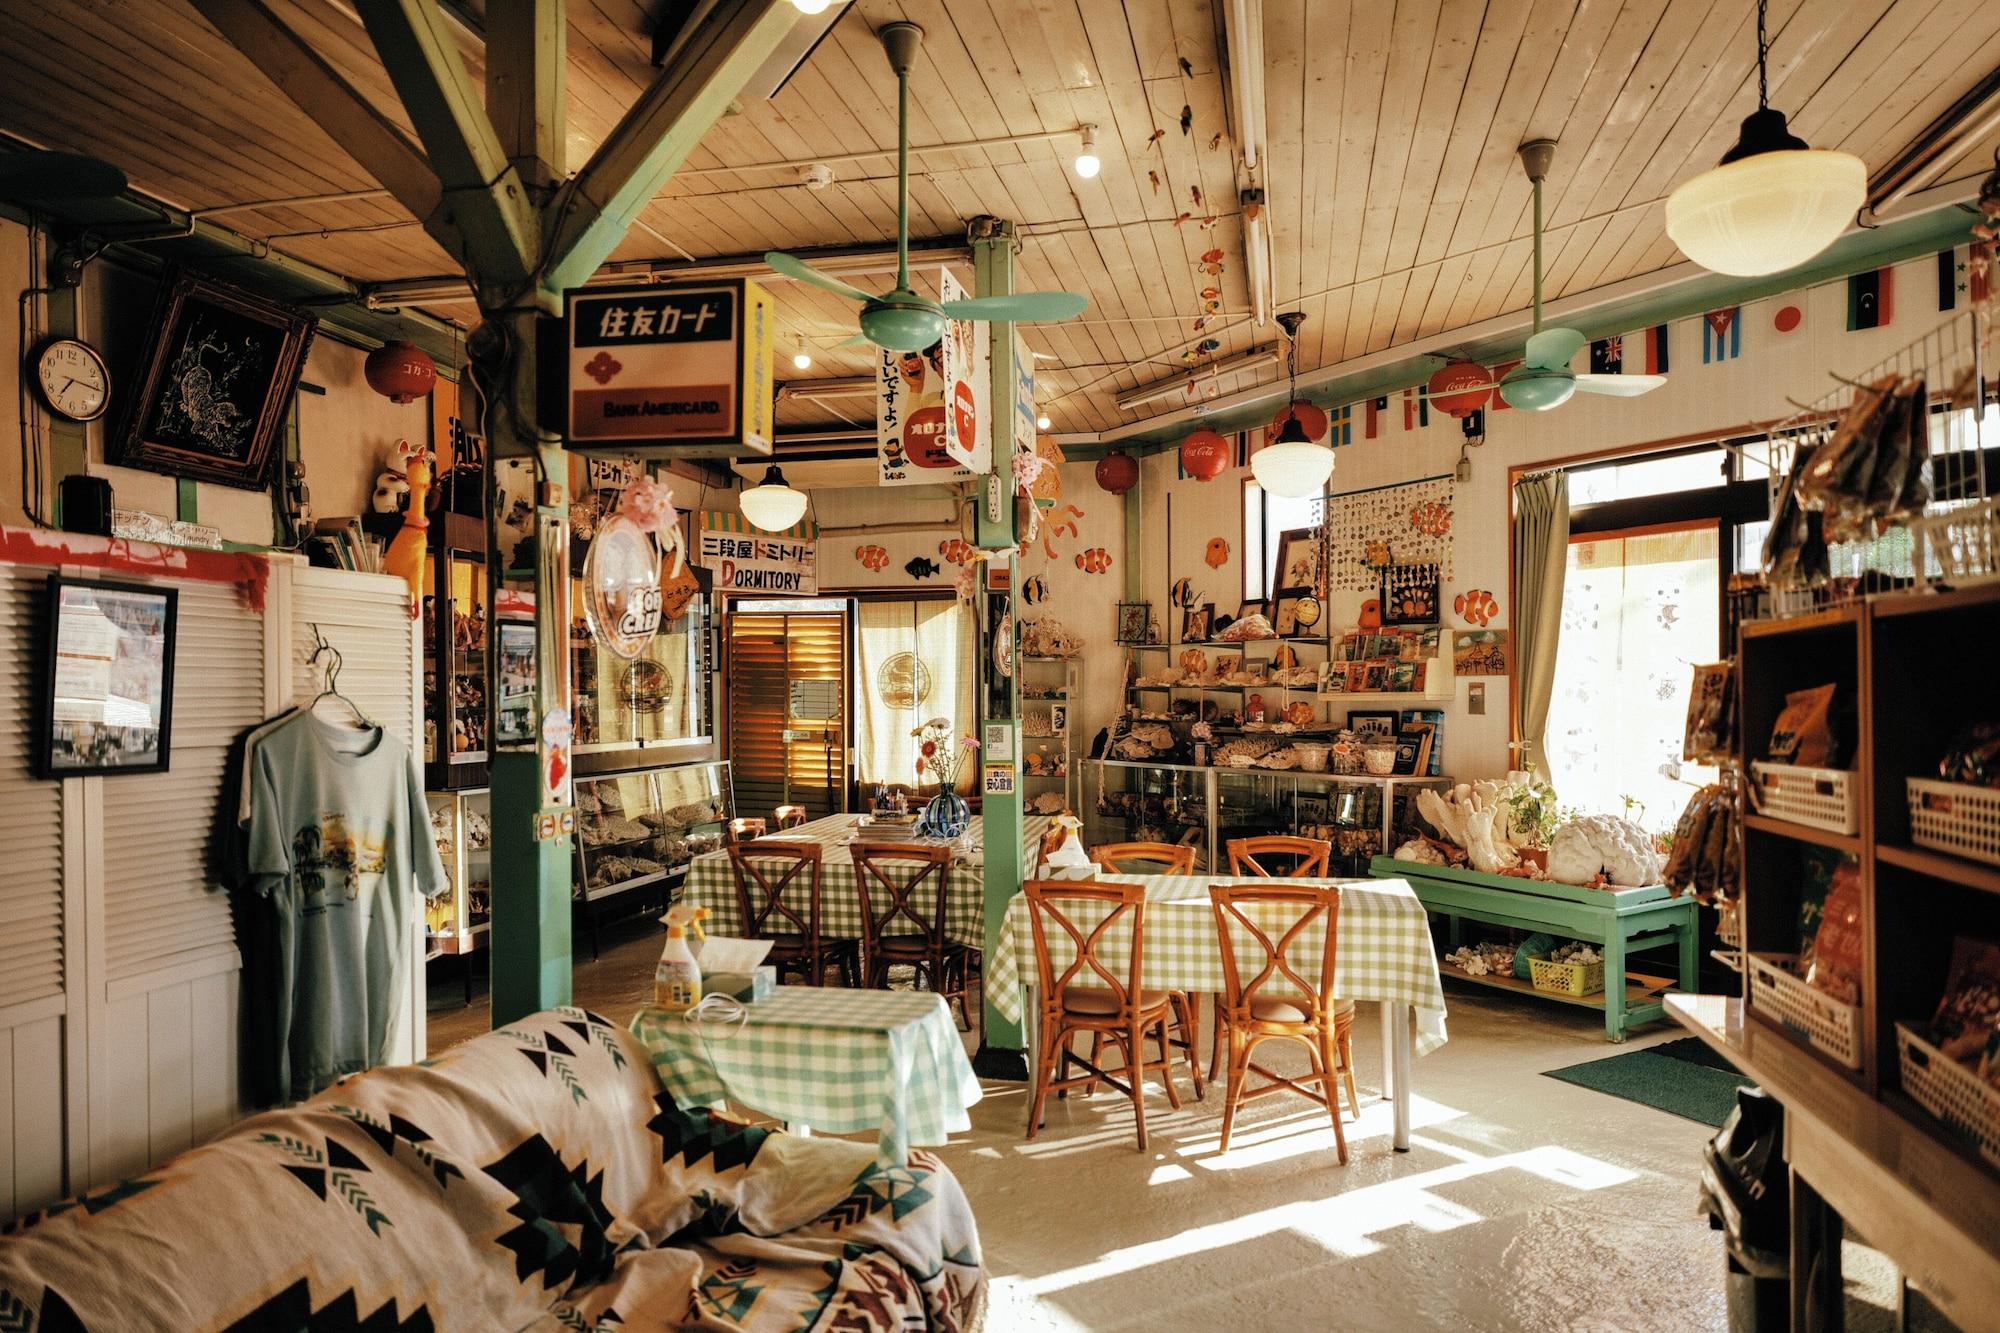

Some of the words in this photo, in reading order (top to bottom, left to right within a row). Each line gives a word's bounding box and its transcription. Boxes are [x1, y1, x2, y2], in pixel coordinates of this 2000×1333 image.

[599, 302, 716, 338] 住友カード
[56, 349, 63, 360] 11
[68, 349, 77, 361] 12
[47, 356, 56, 367] 10
[44, 369, 51, 379] 9
[89, 367, 96, 378] 2
[47, 383, 55, 393] 8
[882, 348, 900, 433] しいですよ!
[56, 394, 64, 405] 7
[68, 400, 76, 411] 6
[80, 400, 88, 411] 5
[702, 537, 815, 562] 三段屋ドミトリー
[721, 559, 801, 590] DORMITORY
[986, 778, 1013, 791] 安心宣言
